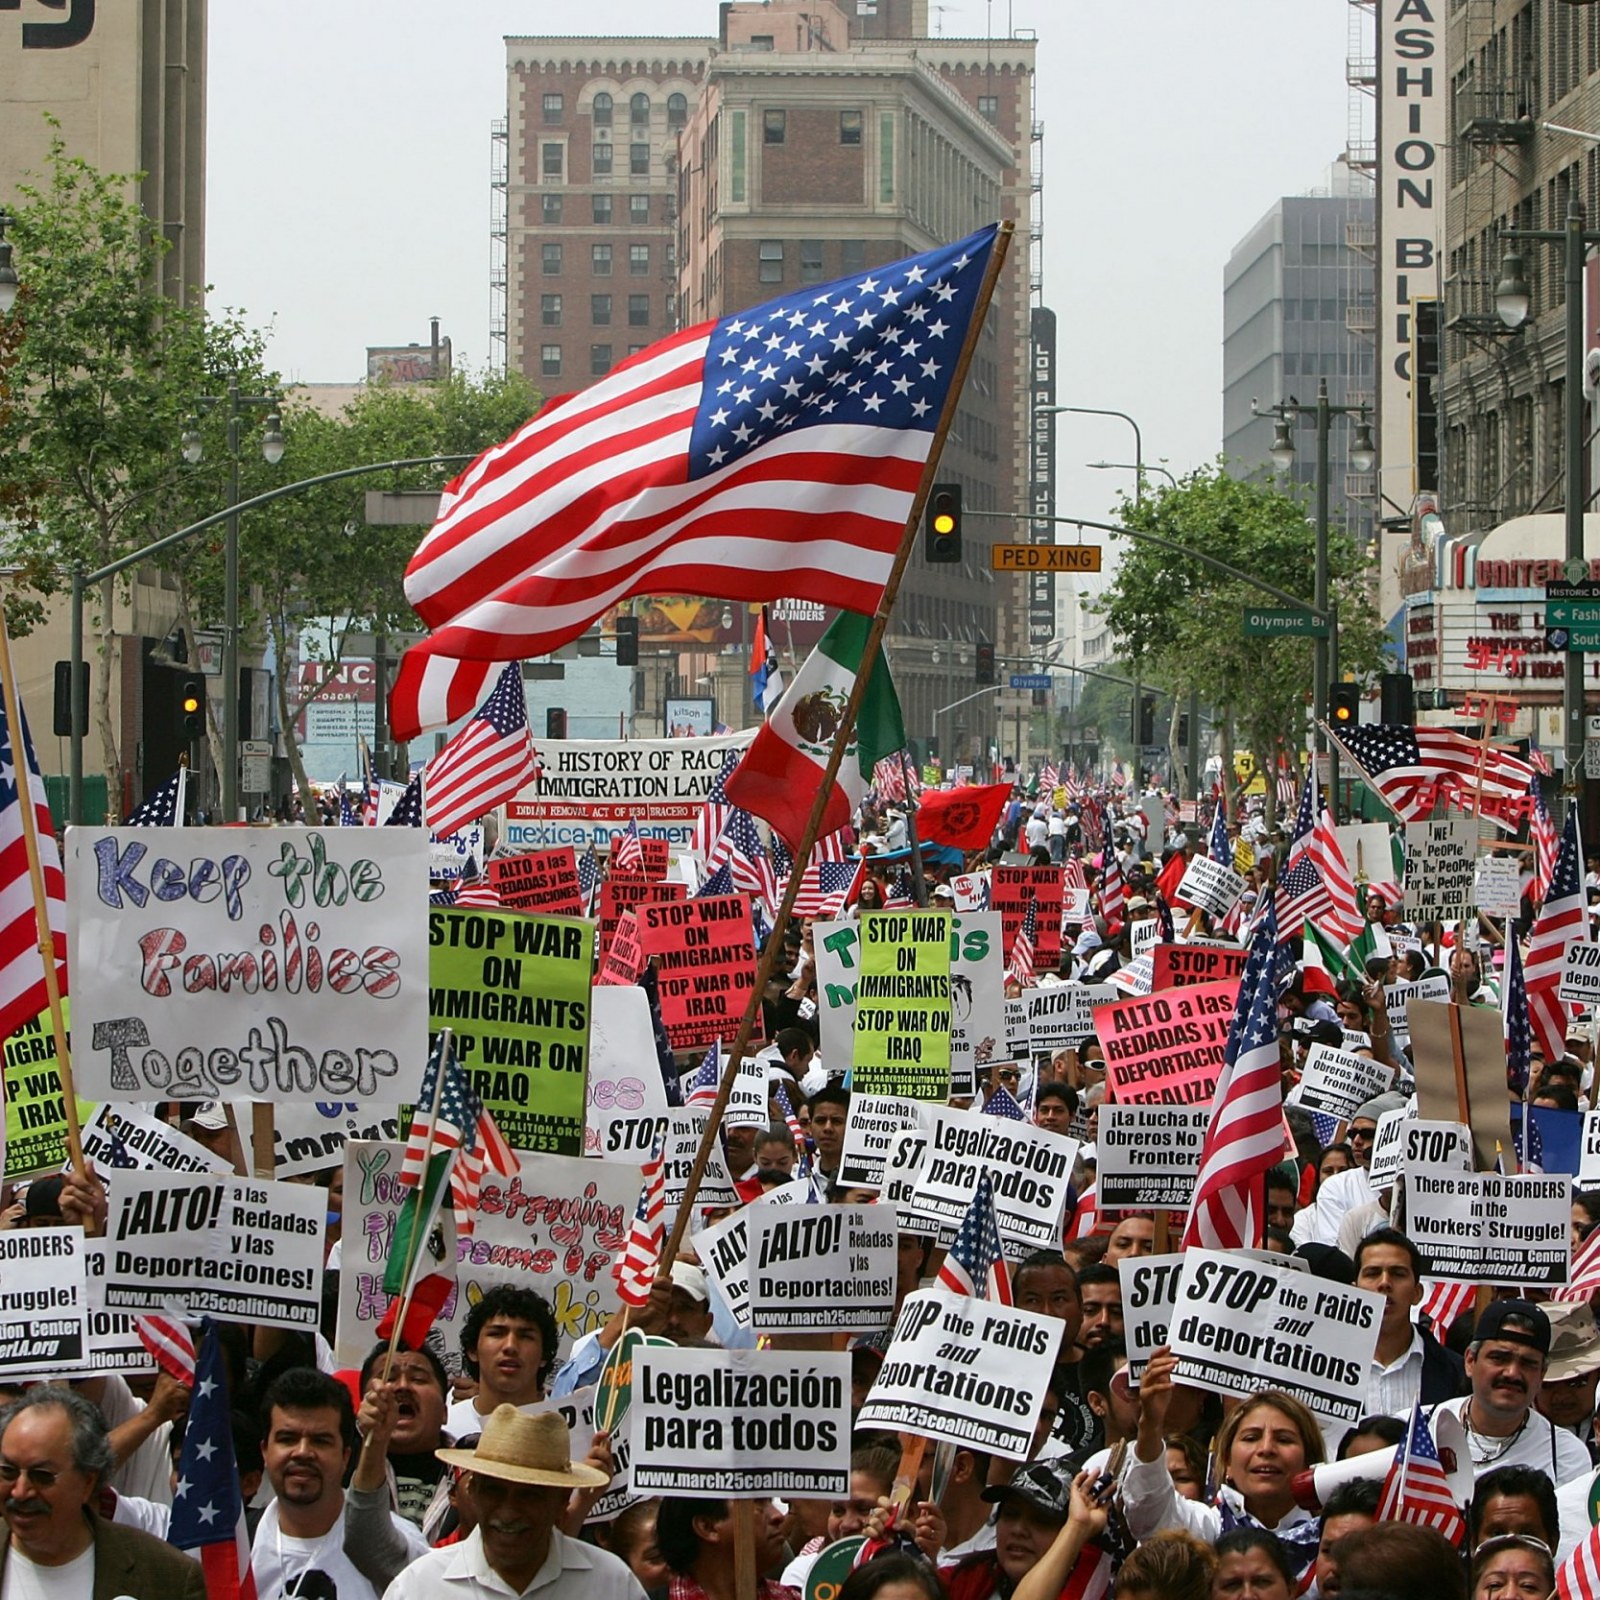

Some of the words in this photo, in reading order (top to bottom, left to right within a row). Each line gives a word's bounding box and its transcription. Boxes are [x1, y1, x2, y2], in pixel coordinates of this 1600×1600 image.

[1036, 343, 1049, 382] LOS
[1036, 391, 1049, 483] AGELES
[1002, 549, 1040, 567] PED
[1047, 549, 1093, 567] XING
[772, 610, 827, 622] POUNDERS
[1249, 615, 1304, 631] Olympic
[1487, 612, 1520, 632] THE
[1031, 624, 1053, 637] YWCA
[1013, 676, 1049, 688] Olympic
[673, 705, 701, 719] kitson
[557, 751, 644, 773] HISTORY
[648, 751, 675, 771] OF
[536, 777, 670, 798] IMMIGRATION
[550, 805, 589, 817] REMOVAL
[591, 806, 611, 817] ACT
[614, 806, 626, 817] OF
[650, 805, 688, 817] BRACERO
[93, 834, 253, 921] Keep
[267, 831, 386, 909] the
[499, 858, 533, 879] ALTO
[536, 860, 545, 872] a
[549, 854, 568, 868] las
[557, 869, 576, 884] las
[997, 869, 1029, 884] STOP
[1031, 869, 1059, 884] WAR
[499, 884, 579, 909] EPORTACIONES
[611, 885, 649, 901] STOP
[651, 885, 677, 901] THE
[1020, 885, 1036, 900] ON
[646, 903, 696, 928] STOP
[700, 898, 744, 921] WAR
[429, 913, 506, 952] STOP
[512, 919, 582, 960] WAR
[684, 927, 710, 948] ON
[868, 916, 909, 943] STOP
[911, 916, 946, 943] WAR
[138, 908, 402, 1000] Families
[896, 947, 917, 972] ON
[1168, 950, 1218, 975] STOP
[1567, 944, 1600, 968] STO
[482, 955, 523, 991] ON
[694, 976, 731, 996] WAR
[733, 971, 756, 993] ON
[859, 974, 949, 999] IMMIGRANTS
[429, 987, 586, 1031] MMIGRANTS
[685, 995, 728, 1018] IRAQ
[1028, 991, 1072, 1020] ¡ALTO!
[1112, 998, 1173, 1035] ALTO
[1177, 1004, 1188, 1019] a
[1200, 993, 1234, 1016] las
[856, 1009, 895, 1032] STOP
[897, 1010, 929, 1031] WAR
[930, 1010, 950, 1031] ON
[886, 1036, 922, 1064] IRAQ
[1106, 1021, 1202, 1062] REDADAS
[1202, 1025, 1217, 1042] y
[91, 1016, 399, 1098] Together
[481, 1036, 542, 1069] WAR
[548, 1043, 584, 1074] ON
[1115, 1043, 1226, 1087] DEPORTACIO
[1319, 1048, 1335, 1063] ¡La
[1335, 1053, 1366, 1074] Lucha
[1365, 1064, 1378, 1078] de
[1375, 1069, 1388, 1084] los
[1312, 1060, 1353, 1081] Obreros
[1352, 1073, 1367, 1087] No
[864, 1084, 893, 1096] (323)
[896, 1084, 939, 1098] 228-2753
[857, 1099, 873, 1115] ¡La
[874, 1100, 910, 1117] Lucha
[1110, 1109, 1135, 1130] ¡La
[1137, 1110, 1190, 1128] Lucha
[672, 1119, 691, 1136] the
[850, 1114, 897, 1134] Obreros
[675, 1140, 697, 1156] and
[934, 1119, 1068, 1179] Legalización
[1105, 1128, 1172, 1147] Obreros
[1175, 1129, 1198, 1147] No
[1406, 1129, 1458, 1163] STOP
[926, 1160, 974, 1192] para
[1103, 1175, 1169, 1191] International
[1414, 1175, 1455, 1196] There
[1456, 1180, 1480, 1197] are
[1481, 1180, 1501, 1198] NO
[1503, 1181, 1566, 1200] BORDERS
[115, 1185, 226, 1242] ¡ALTO!
[233, 1188, 243, 1202] a
[245, 1186, 269, 1205] las
[231, 1206, 319, 1238] Redadas
[1470, 1201, 1483, 1217] in
[1485, 1201, 1508, 1218] the
[758, 1213, 843, 1271] ¡ALTO!
[848, 1215, 855, 1227] a
[855, 1214, 865, 1227] las
[849, 1230, 894, 1249] Redadas
[1413, 1216, 1486, 1239] Workers'
[1488, 1220, 1566, 1243] Struggle!
[231, 1233, 242, 1256] y
[245, 1234, 275, 1256] las
[1485, 1246, 1524, 1262] Action
[1527, 1249, 1567, 1264] Center
[114, 1253, 315, 1292] Deportaciones!
[849, 1256, 857, 1274] y
[856, 1254, 870, 1272] las
[758, 1277, 894, 1301] Deportaciones!
[1185, 1259, 1279, 1315] STOP
[1278, 1287, 1308, 1312] the
[1312, 1291, 1375, 1331] raids
[29, 1317, 80, 1337] Center
[942, 1312, 975, 1338] the
[981, 1316, 1050, 1356] raids
[1273, 1313, 1316, 1339] and
[935, 1340, 983, 1367] and
[1177, 1314, 1363, 1388] deportations
[640, 1365, 843, 1412] Legalización
[643, 1414, 724, 1453] para
[730, 1412, 839, 1453] todos
[635, 1469, 847, 1494] www.march25coalition.org
